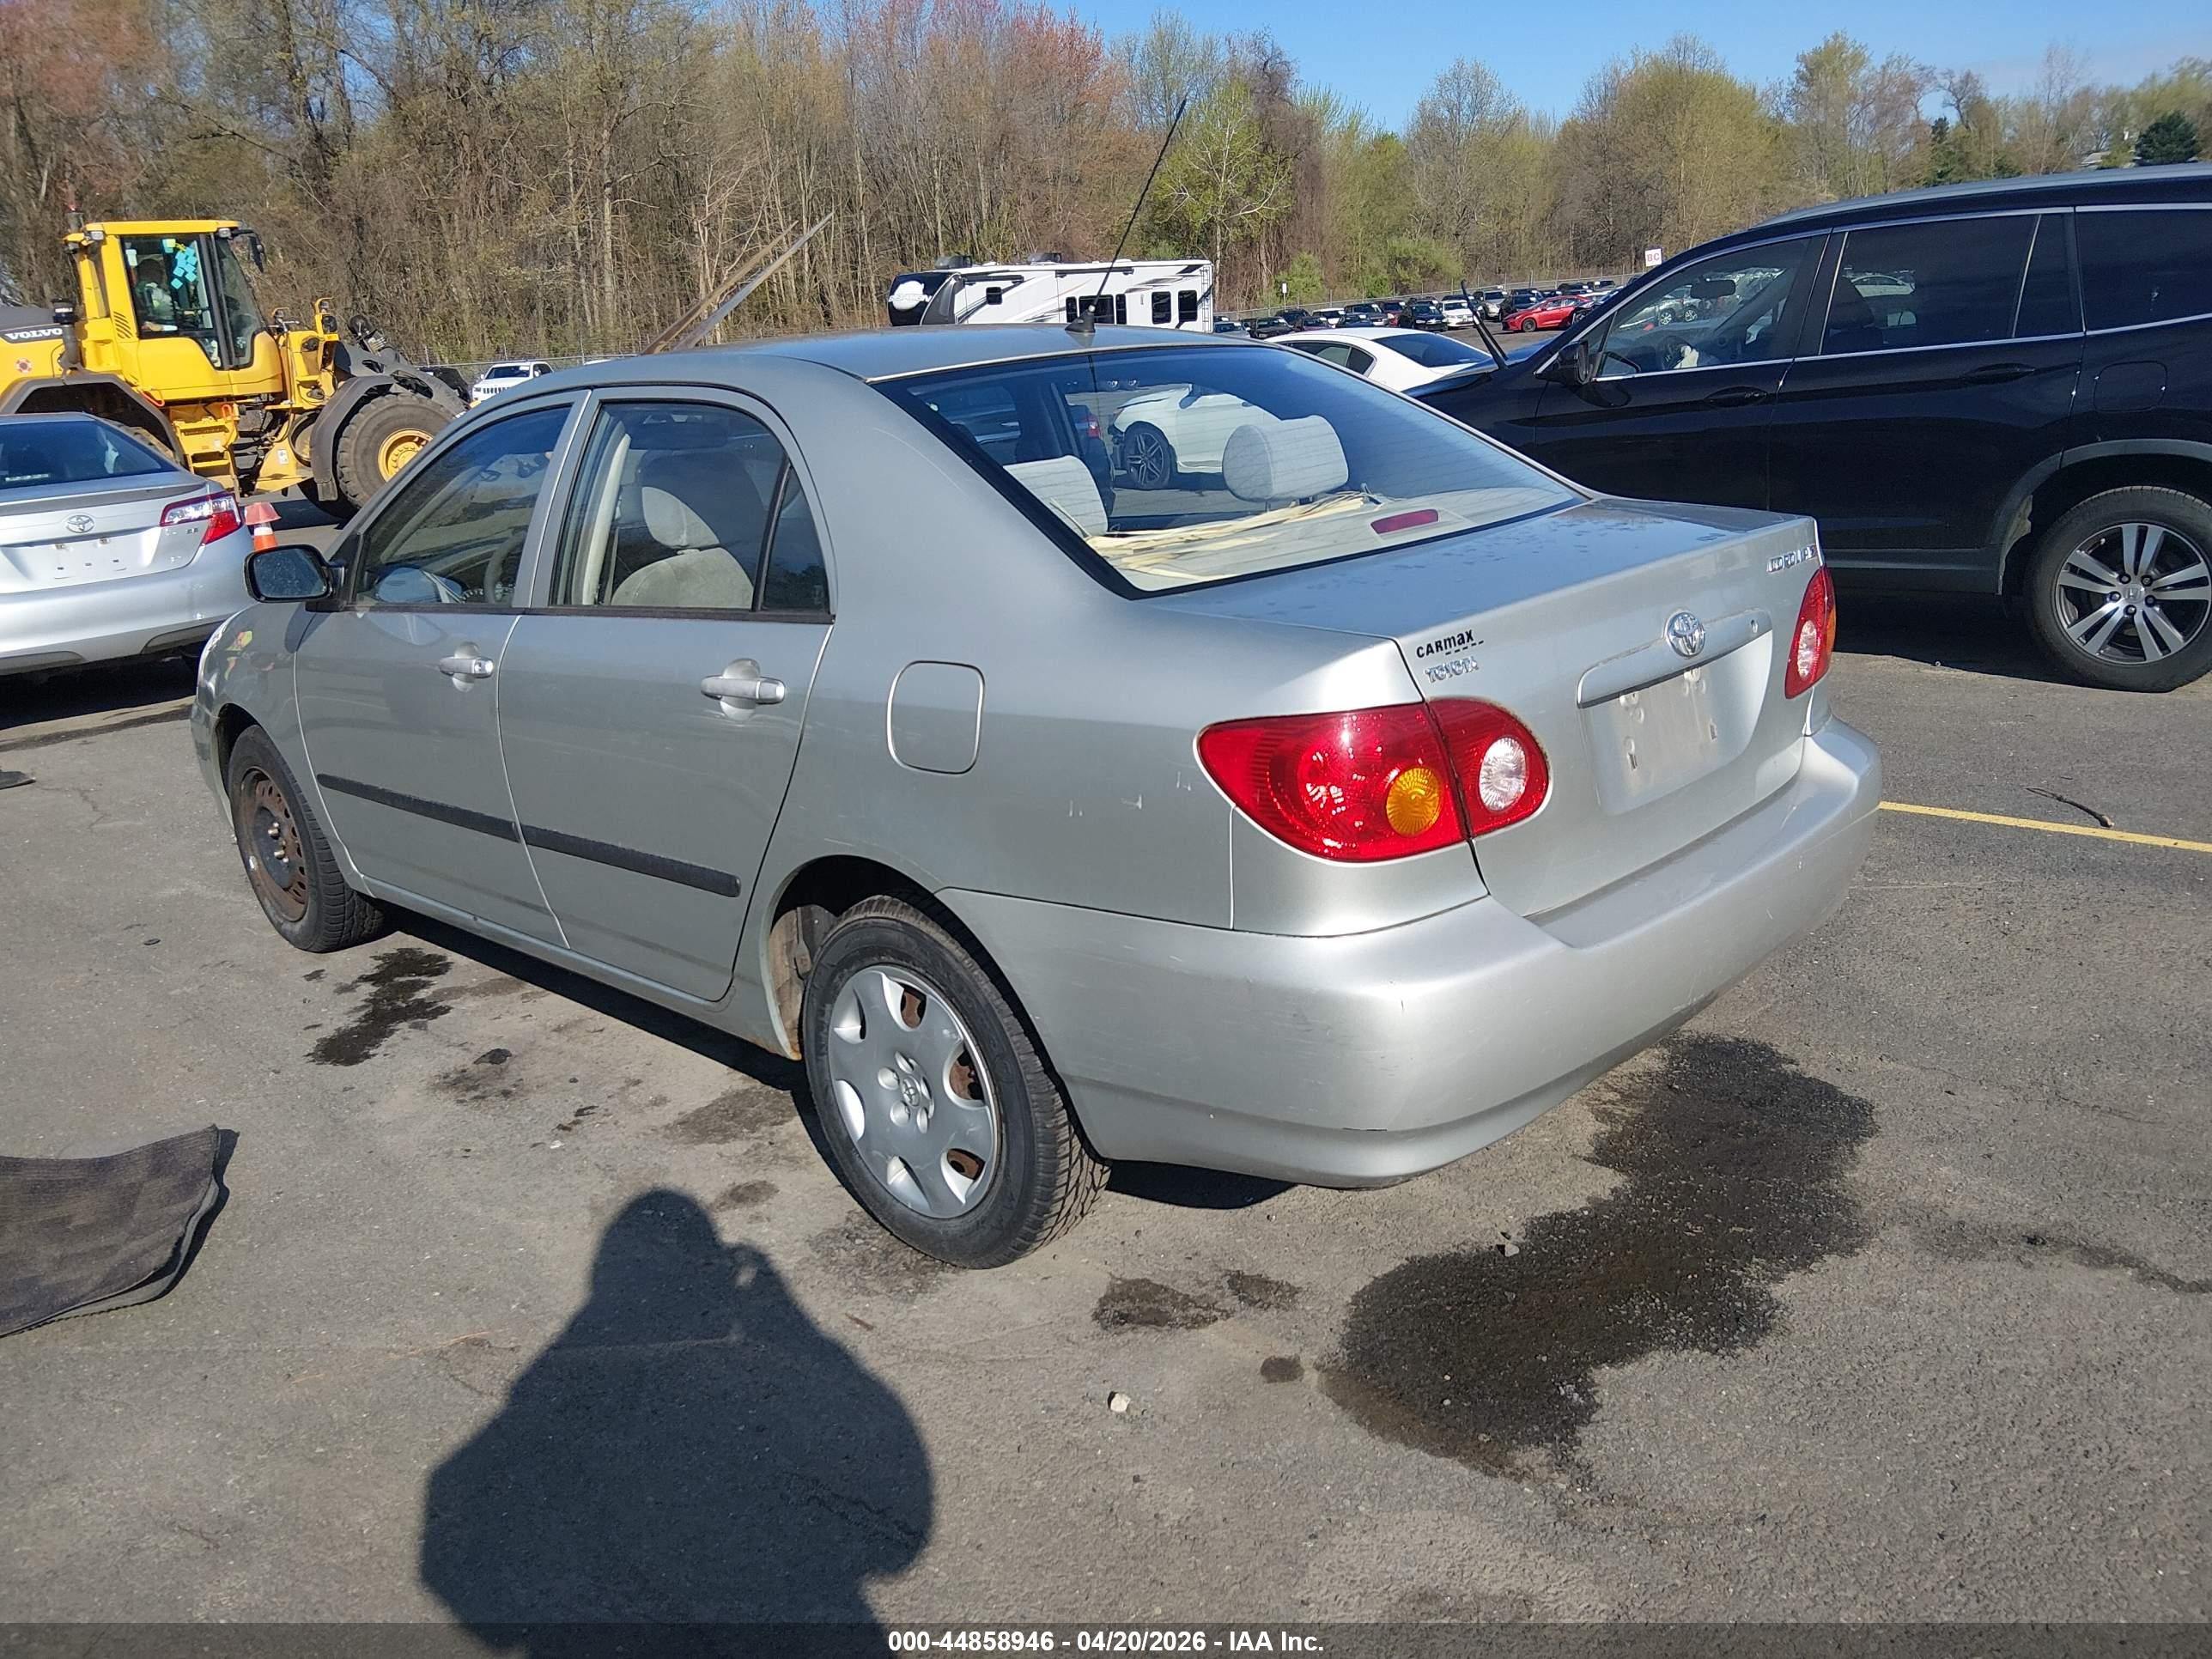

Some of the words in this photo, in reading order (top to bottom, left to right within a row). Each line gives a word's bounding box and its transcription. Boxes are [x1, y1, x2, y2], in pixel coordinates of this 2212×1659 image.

[1647, 253, 1659, 262] BC
[4, 328, 63, 340] VOLVO
[1425, 657, 1479, 684] TOYOTA
